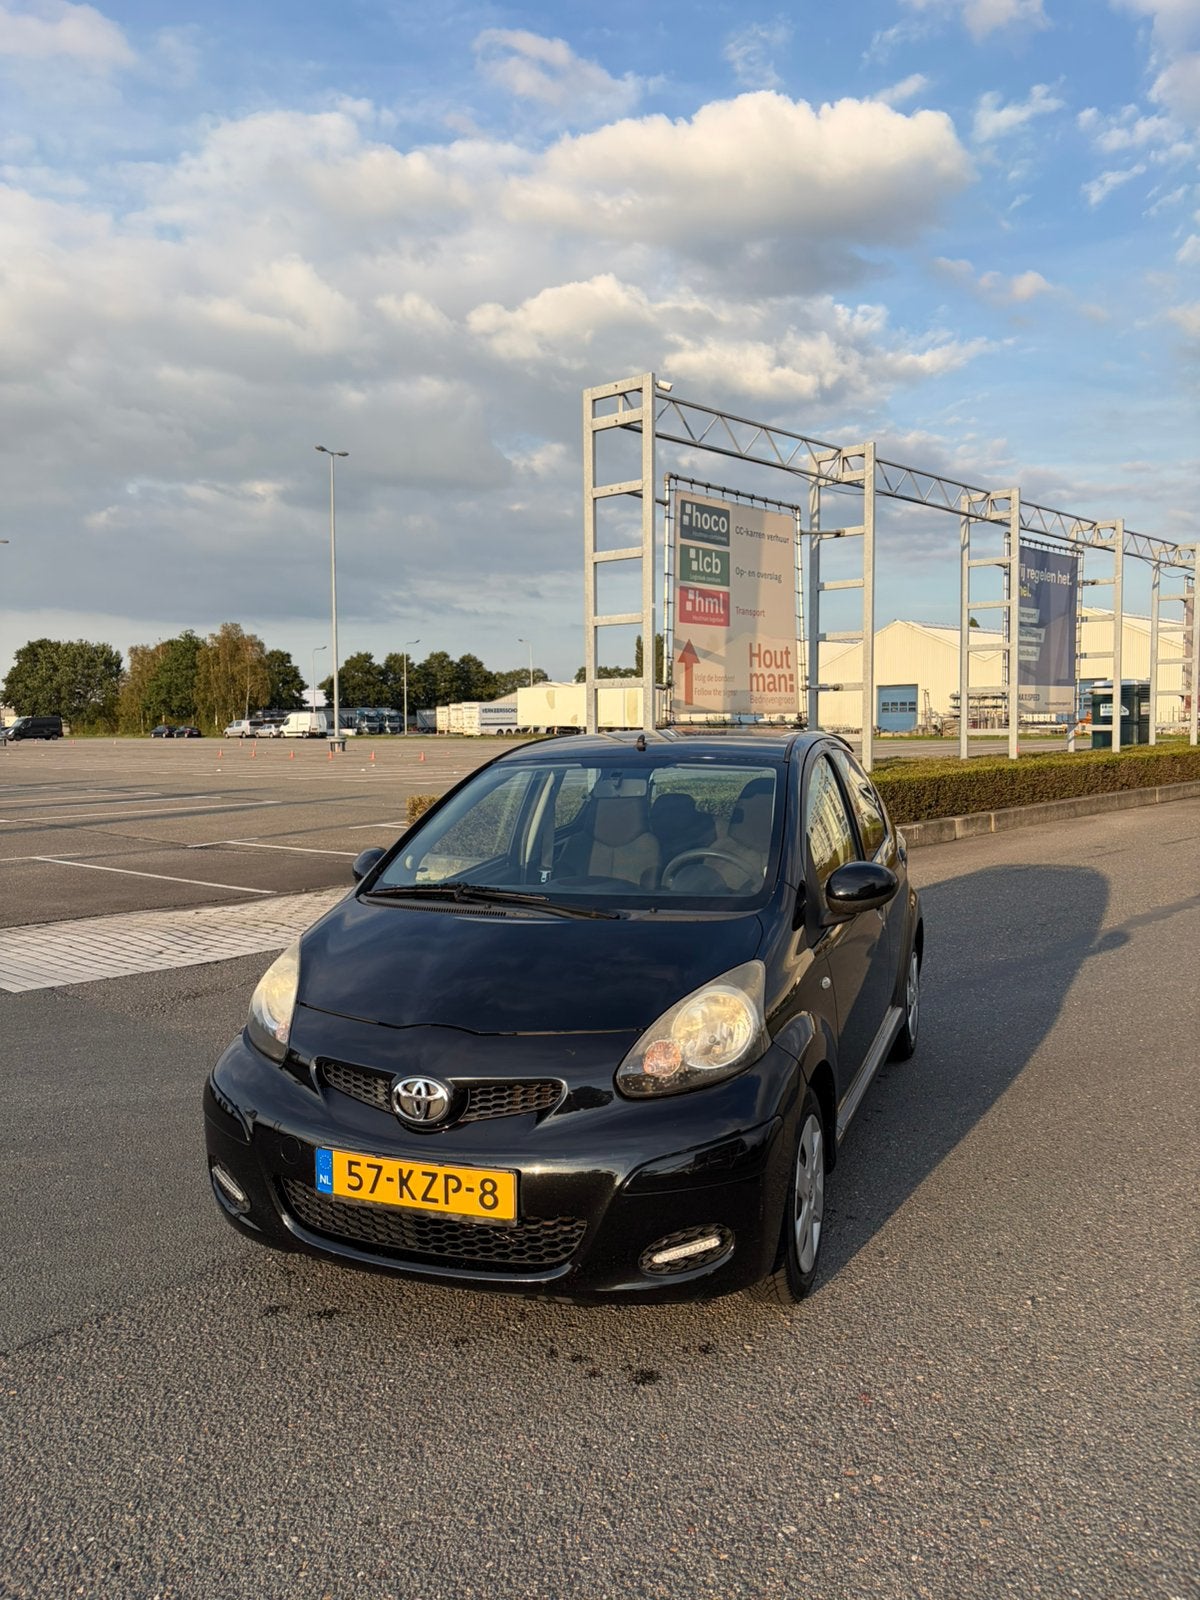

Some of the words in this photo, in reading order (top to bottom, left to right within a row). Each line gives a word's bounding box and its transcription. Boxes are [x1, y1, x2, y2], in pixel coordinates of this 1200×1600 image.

[692, 505, 728, 533] hoco
[735, 525, 765, 539] CC-karren
[766, 533, 790, 544] verhuur
[699, 549, 721, 574] lcb
[735, 567, 747, 577] Op-
[748, 570, 756, 578] en
[757, 571, 782, 584] overslag
[1027, 568, 1056, 584] regelen
[1057, 570, 1073, 586] het.
[695, 590, 724, 615] hml
[735, 606, 766, 618] Transport
[749, 642, 791, 669] Hout
[712, 687, 722, 697] the
[319, 1174, 331, 1186] NL
[347, 1160, 499, 1211] 57-KZP-8
